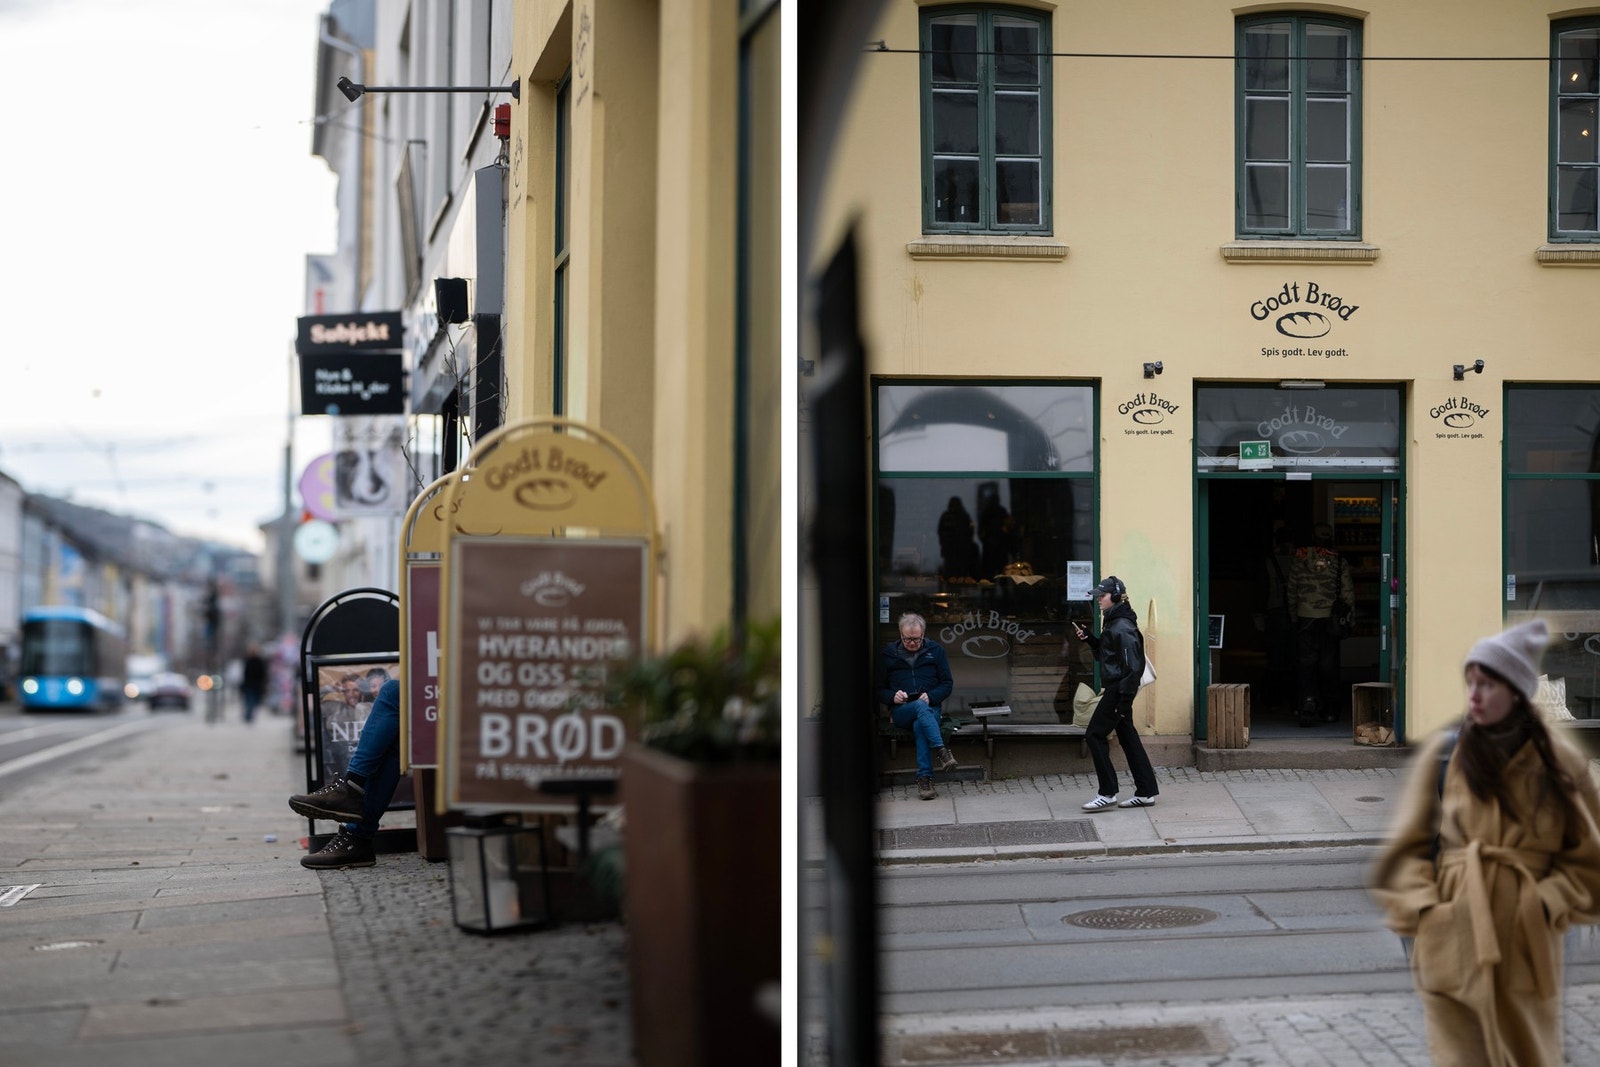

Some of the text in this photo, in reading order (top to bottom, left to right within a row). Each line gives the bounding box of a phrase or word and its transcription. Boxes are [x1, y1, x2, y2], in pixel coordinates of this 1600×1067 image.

[1250, 281, 1360, 321] Godt Brød
[310, 321, 390, 346] Subjekt
[1261, 347, 1349, 359] Spis godt. Lev godt.
[1118, 392, 1180, 415] Godt Brød
[1429, 396, 1490, 419] Godt Brød
[1256, 404, 1350, 440] Godt Brød
[484, 445, 608, 491] Godt Brød
[939, 609, 1036, 645] Godt Brød
[477, 661, 513, 686] OG
[517, 662, 565, 687] OSS
[477, 688, 520, 708] MED
[479, 708, 627, 763] BRØD
